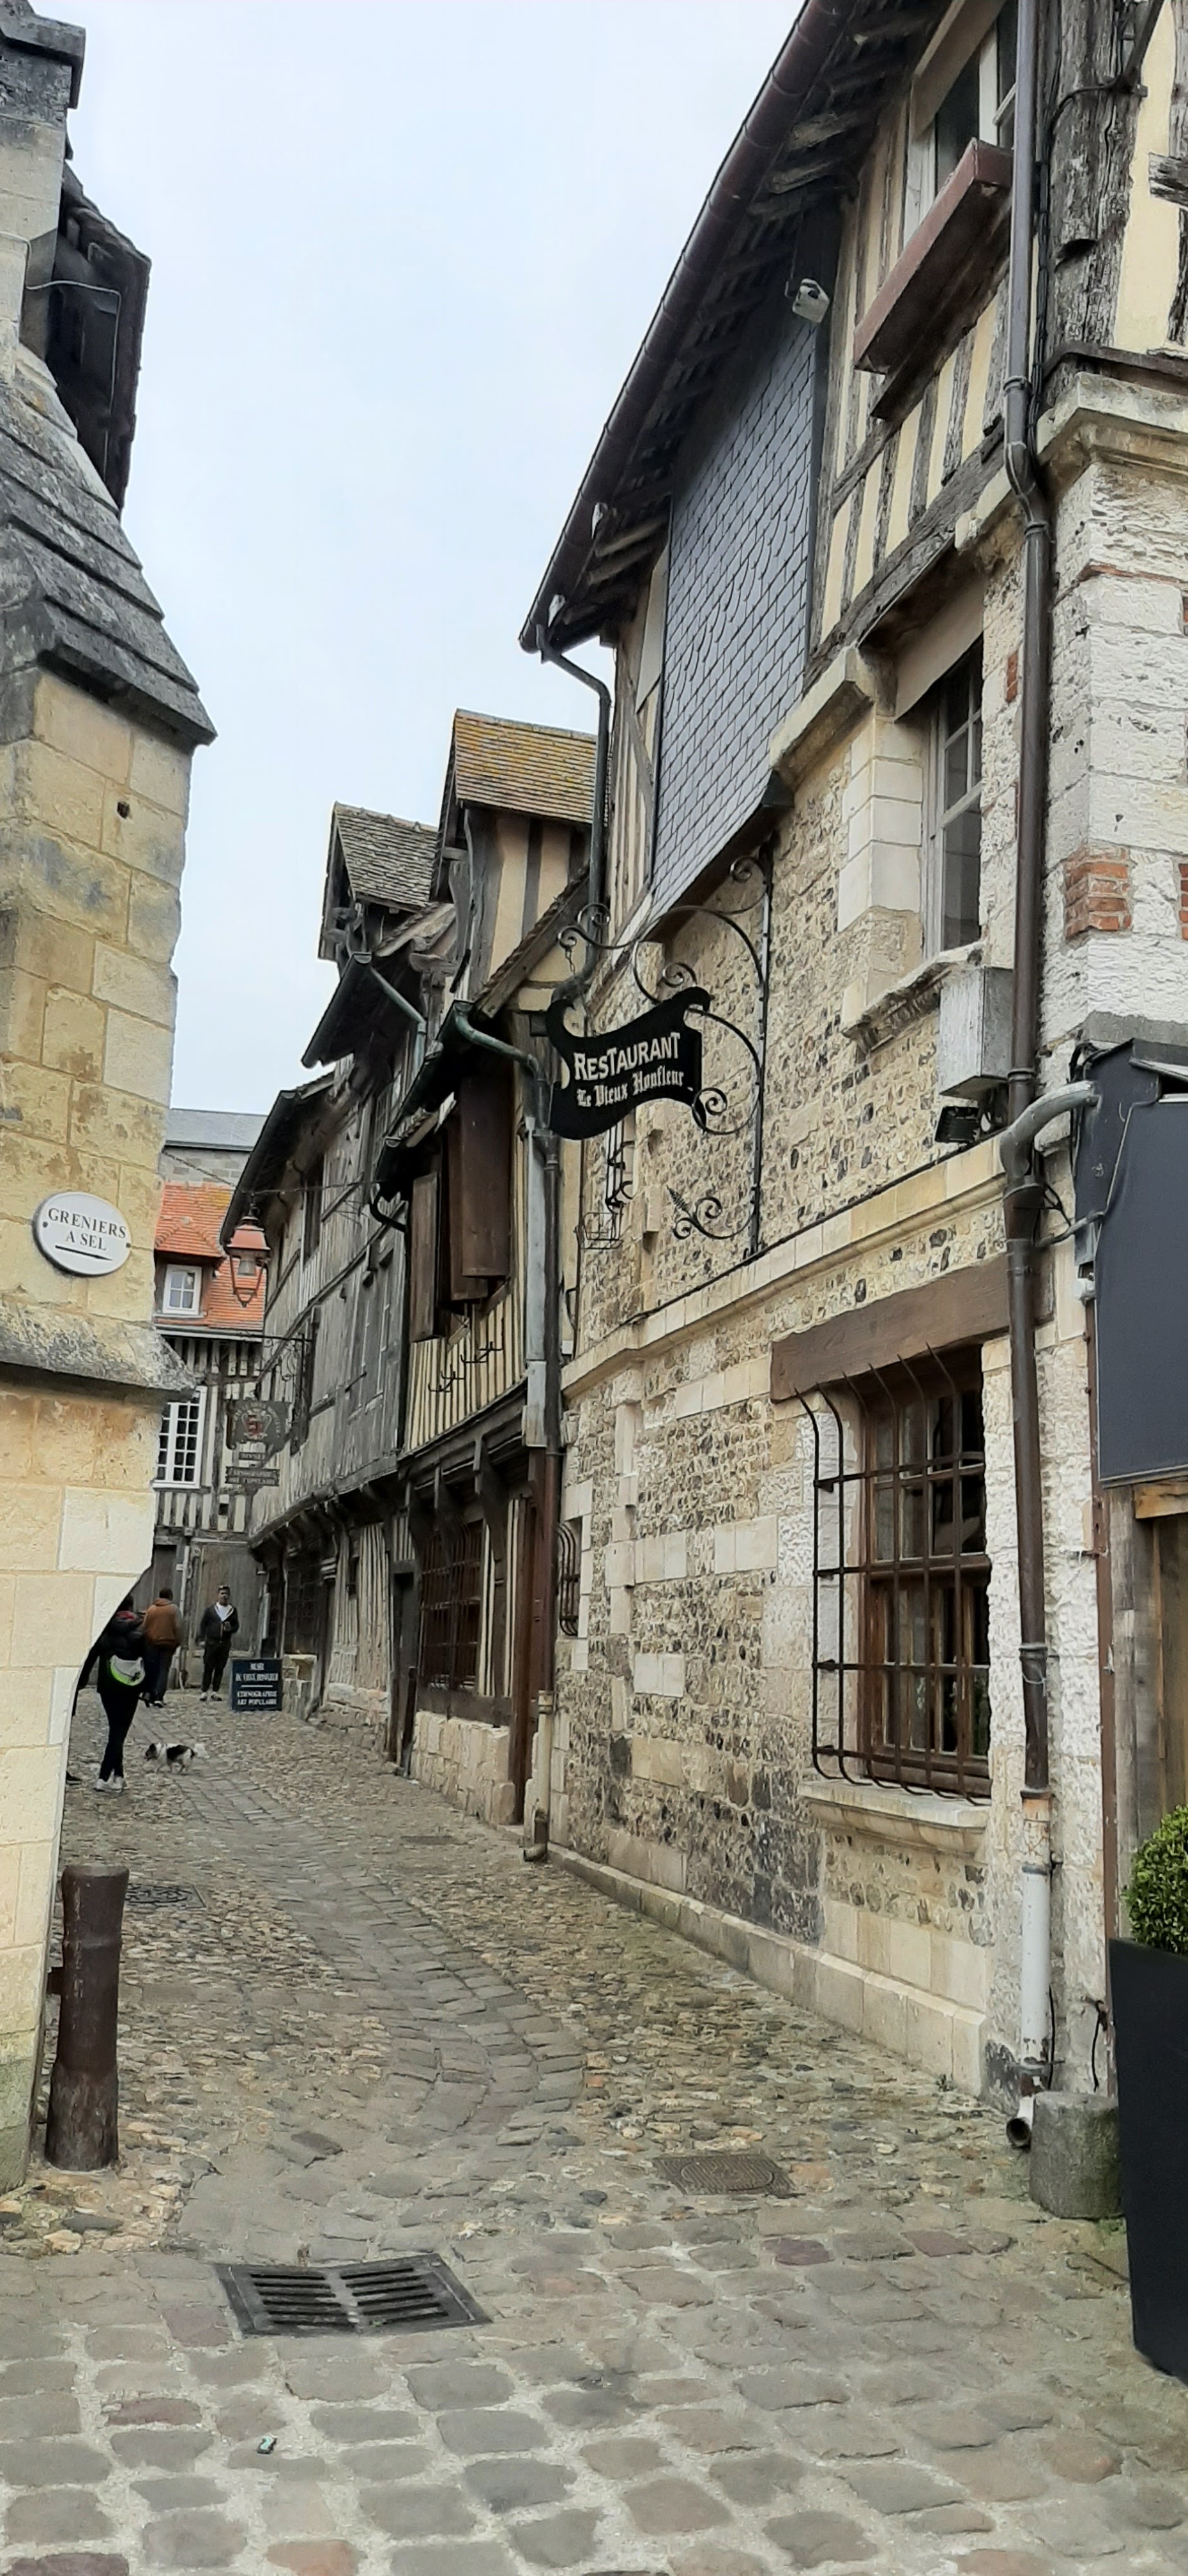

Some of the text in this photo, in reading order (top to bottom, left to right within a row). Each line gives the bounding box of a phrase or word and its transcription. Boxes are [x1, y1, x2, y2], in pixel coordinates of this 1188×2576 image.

[574, 1032, 681, 1080] RESTAURANT
[577, 1065, 684, 1108] Le Vieux Honfleur
[48, 1208, 127, 1239] GRENIERS
[66, 1230, 107, 1251] A SEL
